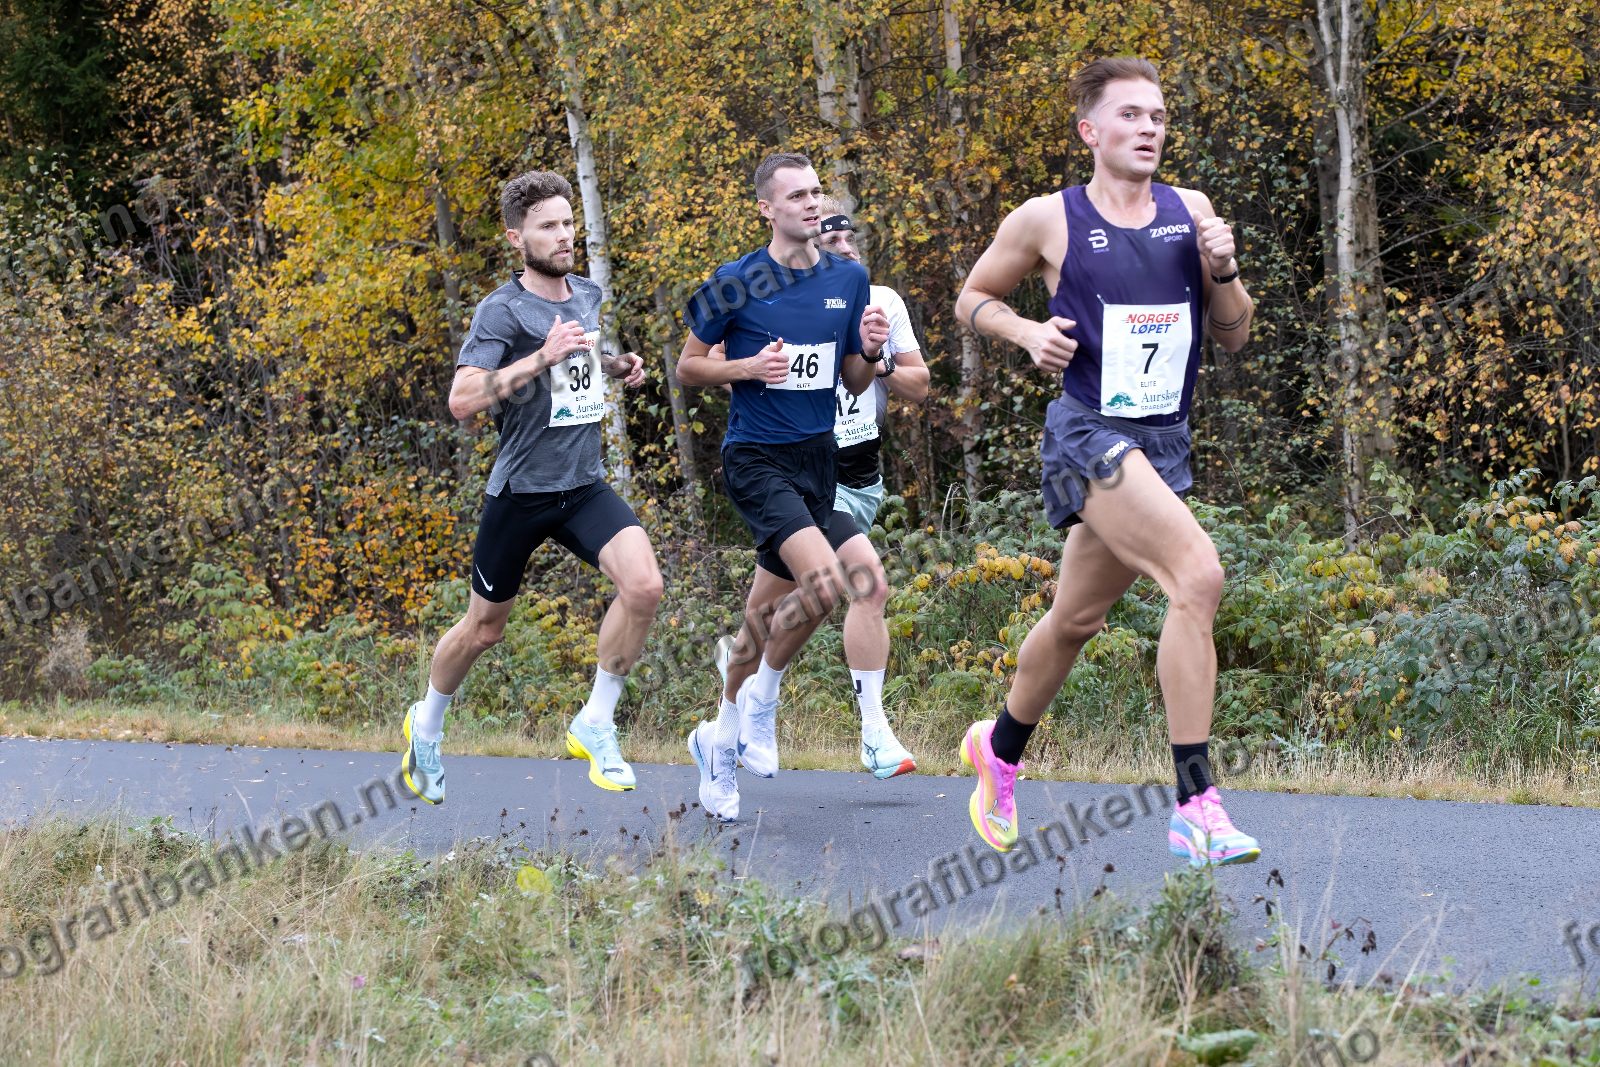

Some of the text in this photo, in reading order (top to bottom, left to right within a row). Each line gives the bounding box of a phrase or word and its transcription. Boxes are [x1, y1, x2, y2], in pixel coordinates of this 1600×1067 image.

[1149, 224, 1190, 238] zooca
[1125, 312, 1180, 324] NORGES
[1131, 323, 1172, 335] LØPET
[790, 352, 819, 379] 46
[1141, 343, 1159, 375] 7
[568, 363, 591, 393] 38
[1140, 380, 1157, 388] ELITE
